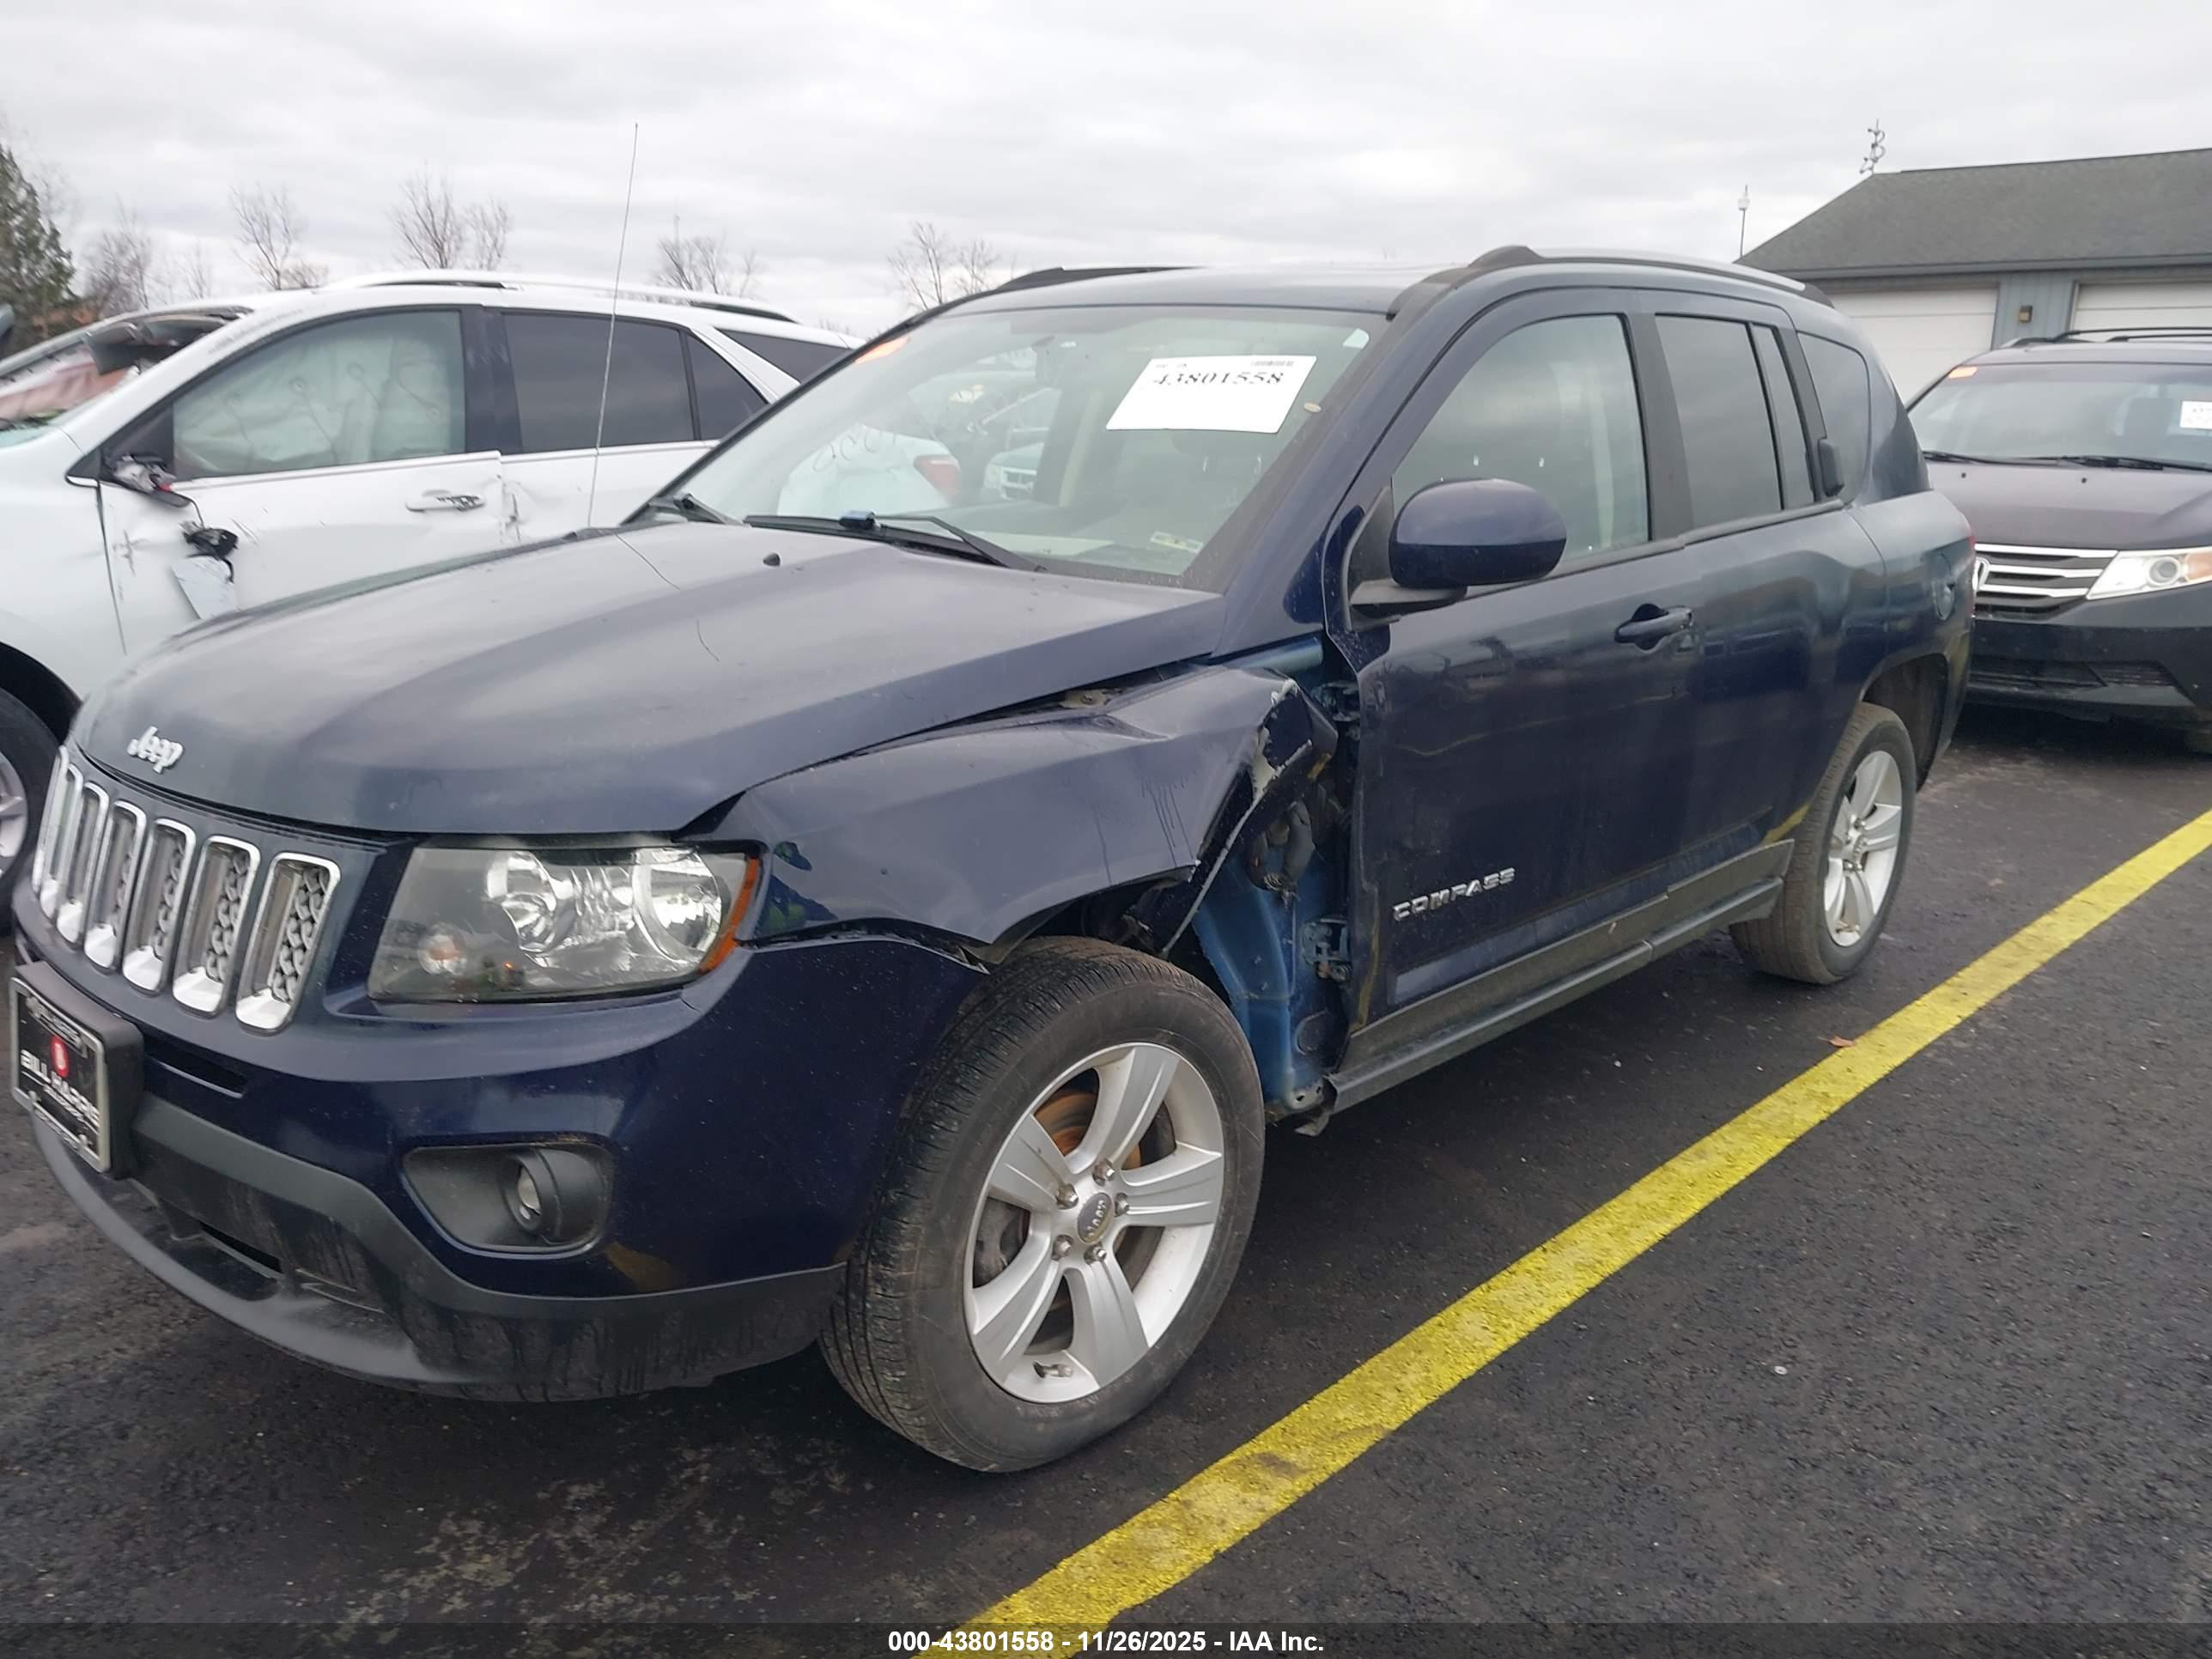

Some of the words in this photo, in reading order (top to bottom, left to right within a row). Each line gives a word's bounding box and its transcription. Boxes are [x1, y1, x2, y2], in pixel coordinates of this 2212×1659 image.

[1152, 370, 1285, 386] 43801558
[126, 726, 184, 774] Jeep
[1393, 866, 1516, 922] COMPASS
